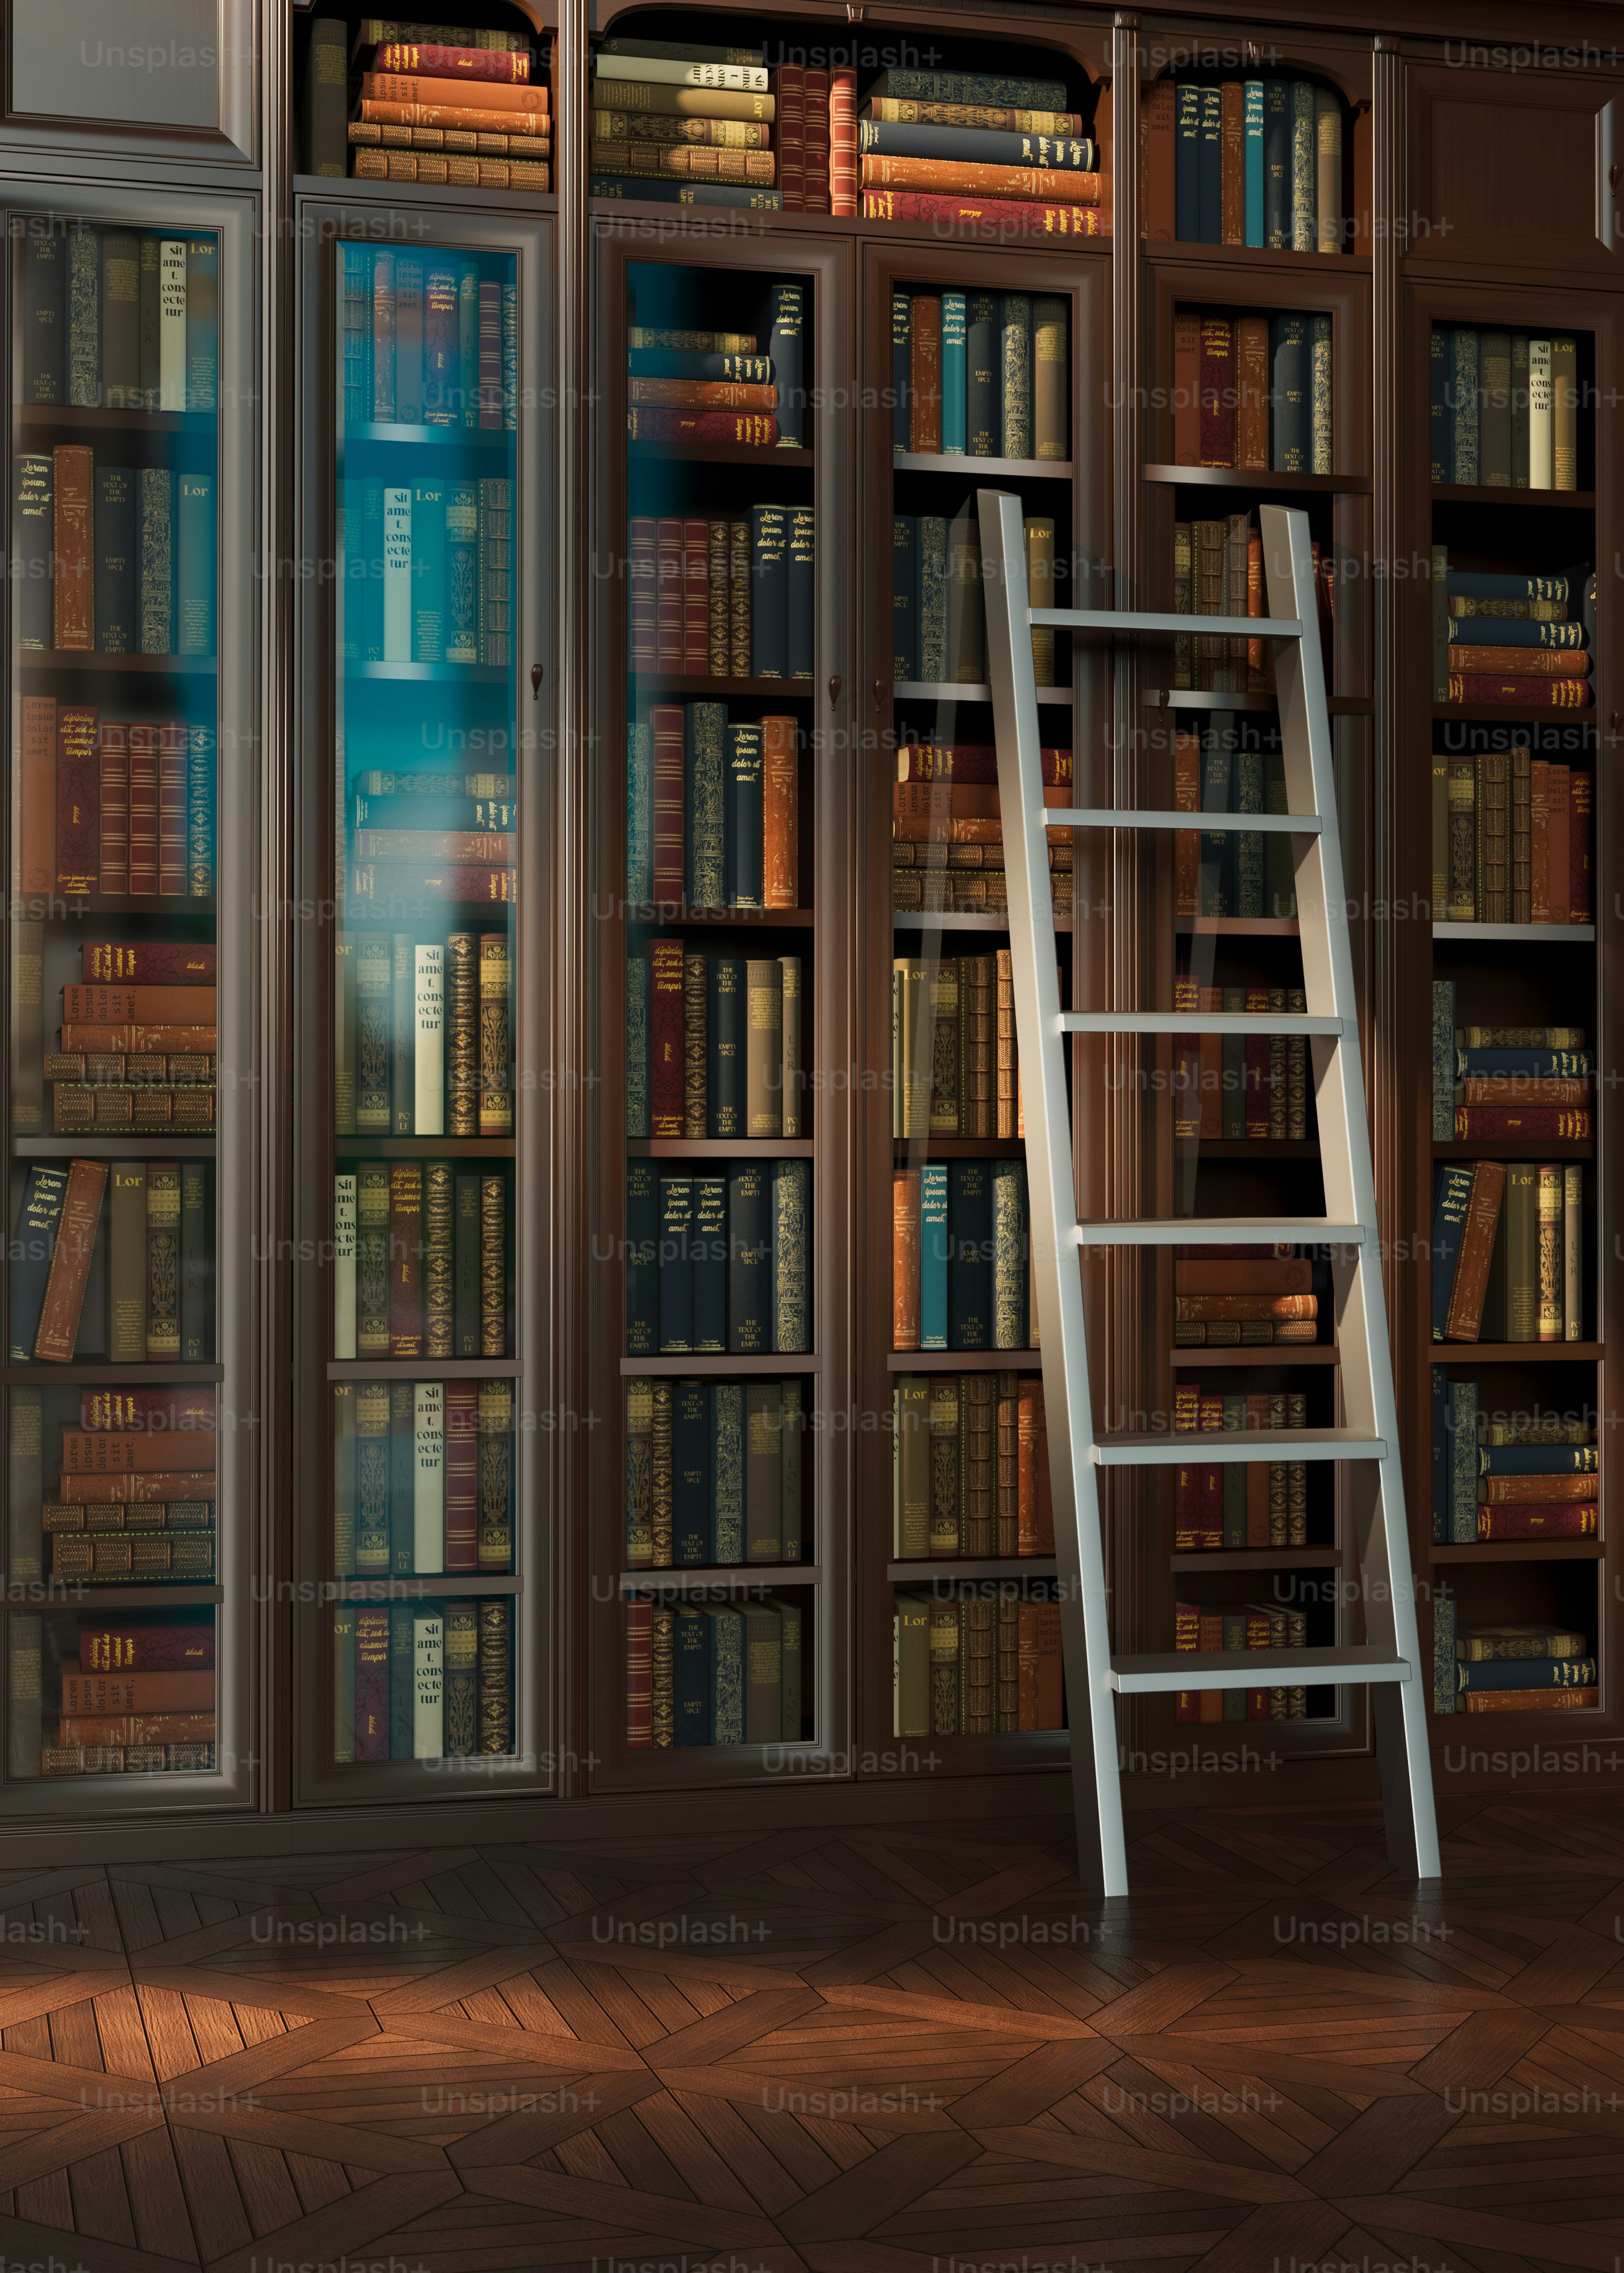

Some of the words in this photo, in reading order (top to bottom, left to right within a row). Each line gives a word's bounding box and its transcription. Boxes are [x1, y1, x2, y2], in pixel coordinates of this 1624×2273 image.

[411, 47, 419, 68] tempor
[755, 74, 764, 86] sit
[411, 79, 420, 103] amet,
[1204, 93, 1219, 104] Lorem
[753, 95, 765, 118] Lor
[1205, 108, 1218, 116] ipsum
[1205, 132, 1218, 141] amet,
[1022, 139, 1033, 161] amet,
[1039, 136, 1049, 157] dolor
[1052, 140, 1064, 163] ipsum
[1071, 141, 1085, 166] Lorem
[169, 245, 182, 256] sit
[191, 243, 215, 255] Lor
[163, 259, 185, 268] ame
[162, 283, 186, 292] cons
[163, 295, 185, 305] ecte
[778, 290, 800, 301] Lorem
[165, 307, 183, 317] tur
[780, 303, 799, 313] ipsum
[1538, 344, 1548, 354] sit
[1554, 342, 1574, 352] Lor
[21, 461, 48, 474] Lorem
[22, 478, 46, 488] ipsum
[18, 492, 39, 501] dolor
[40, 493, 52, 502] sit
[394, 493, 407, 503] sit
[416, 489, 442, 502] Lor
[23, 507, 47, 517] amet,
[387, 506, 410, 517] ame
[396, 519, 402, 529] t.
[386, 533, 411, 543] cons
[387, 546, 410, 555] ecte
[390, 558, 408, 568] tur
[64, 736, 94, 744] eiusmod
[734, 730, 759, 743] Lorem
[65, 747, 93, 756] tempor
[735, 746, 757, 756] ipsum
[731, 759, 752, 768] dolor
[752, 760, 762, 769] sit
[736, 773, 758, 782] amet,
[70, 988, 79, 1019] Lorem
[84, 988, 93, 1019] ipsum
[98, 988, 107, 1020] dolor
[128, 990, 138, 1020] amet,
[35, 1175, 62, 1189] Lorem
[115, 1175, 143, 1187] Lor
[924, 1172, 947, 1184] Lorem
[1449, 1174, 1469, 1187] Lorem
[1511, 1174, 1533, 1185] Lor
[667, 1184, 690, 1196] Lorem
[1448, 1188, 1467, 1199] ipsum
[34, 1190, 57, 1202] ipsum
[668, 1199, 688, 1208] ipsum
[1442, 1200, 1460, 1210] dolor
[27, 1204, 48, 1215] dolor
[49, 1207, 60, 1217] sit
[664, 1210, 683, 1219] dolor
[684, 1210, 693, 1219] sit
[1444, 1214, 1463, 1224] amet,
[29, 1220, 53, 1230] amet,
[668, 1223, 689, 1232] amet,
[425, 1388, 439, 1398] sit
[418, 1402, 442, 1412] ame
[427, 1416, 434, 1426] t.
[417, 1430, 443, 1439] cons
[418, 1443, 442, 1454] ecte
[421, 1457, 440, 1467] tur
[425, 1624, 439, 1634] sit
[418, 1639, 442, 1648] ame
[427, 1652, 434, 1662] t.
[417, 1666, 443, 1676] cons
[418, 1680, 442, 1690] ecte
[420, 1693, 440, 1704] tur
